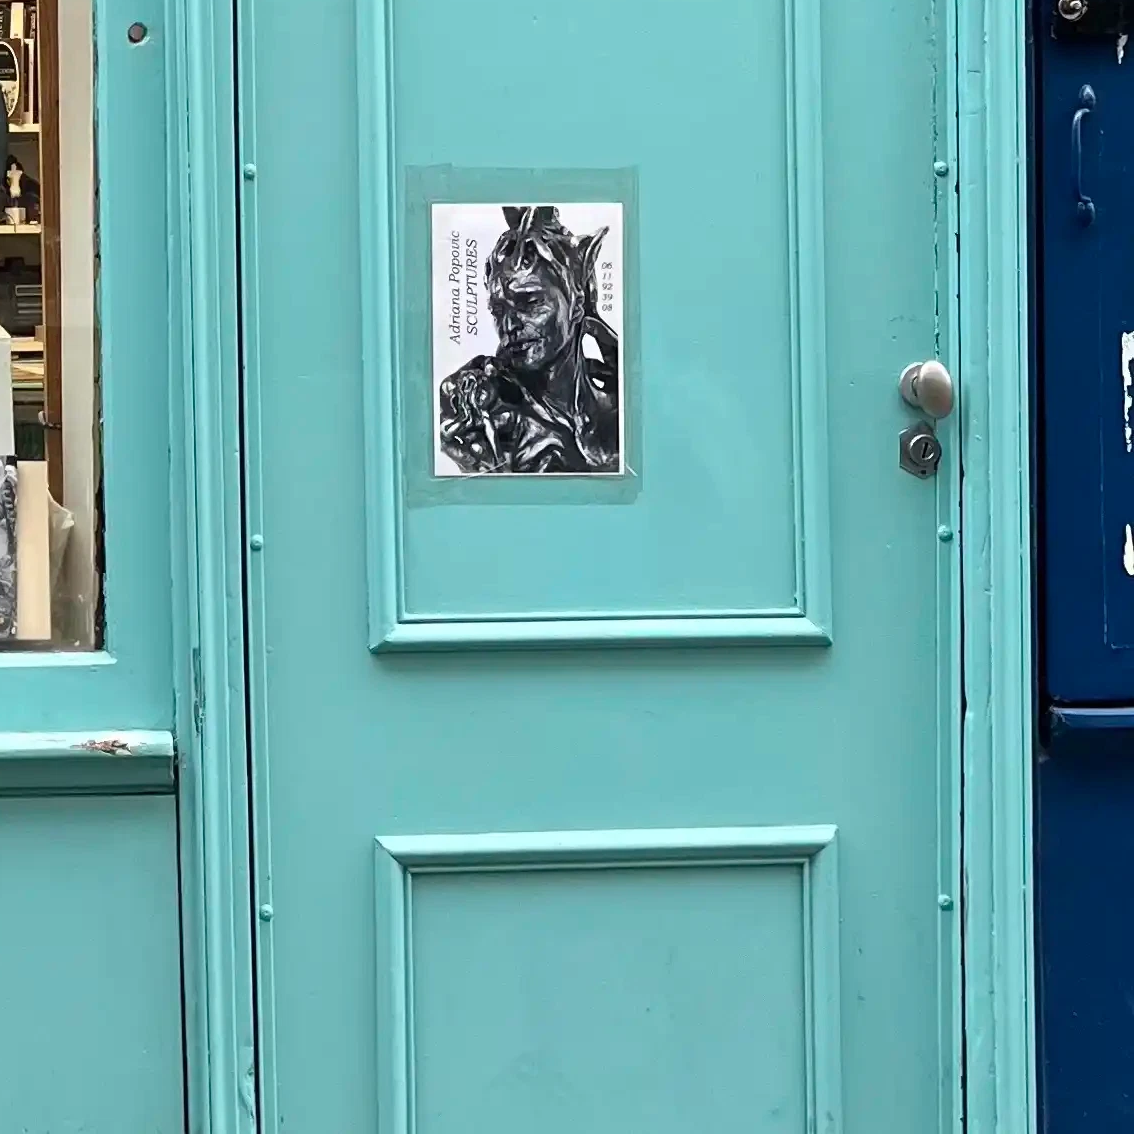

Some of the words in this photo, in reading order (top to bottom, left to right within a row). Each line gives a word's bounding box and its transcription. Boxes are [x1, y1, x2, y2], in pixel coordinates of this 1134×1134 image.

[449, 231, 462, 283] Popovic
[601, 261, 613, 270] 06
[466, 238, 478, 336] SCULPTURES
[601, 282, 613, 290] 92
[602, 293, 613, 301] 39
[449, 288, 461, 345] Adriana
